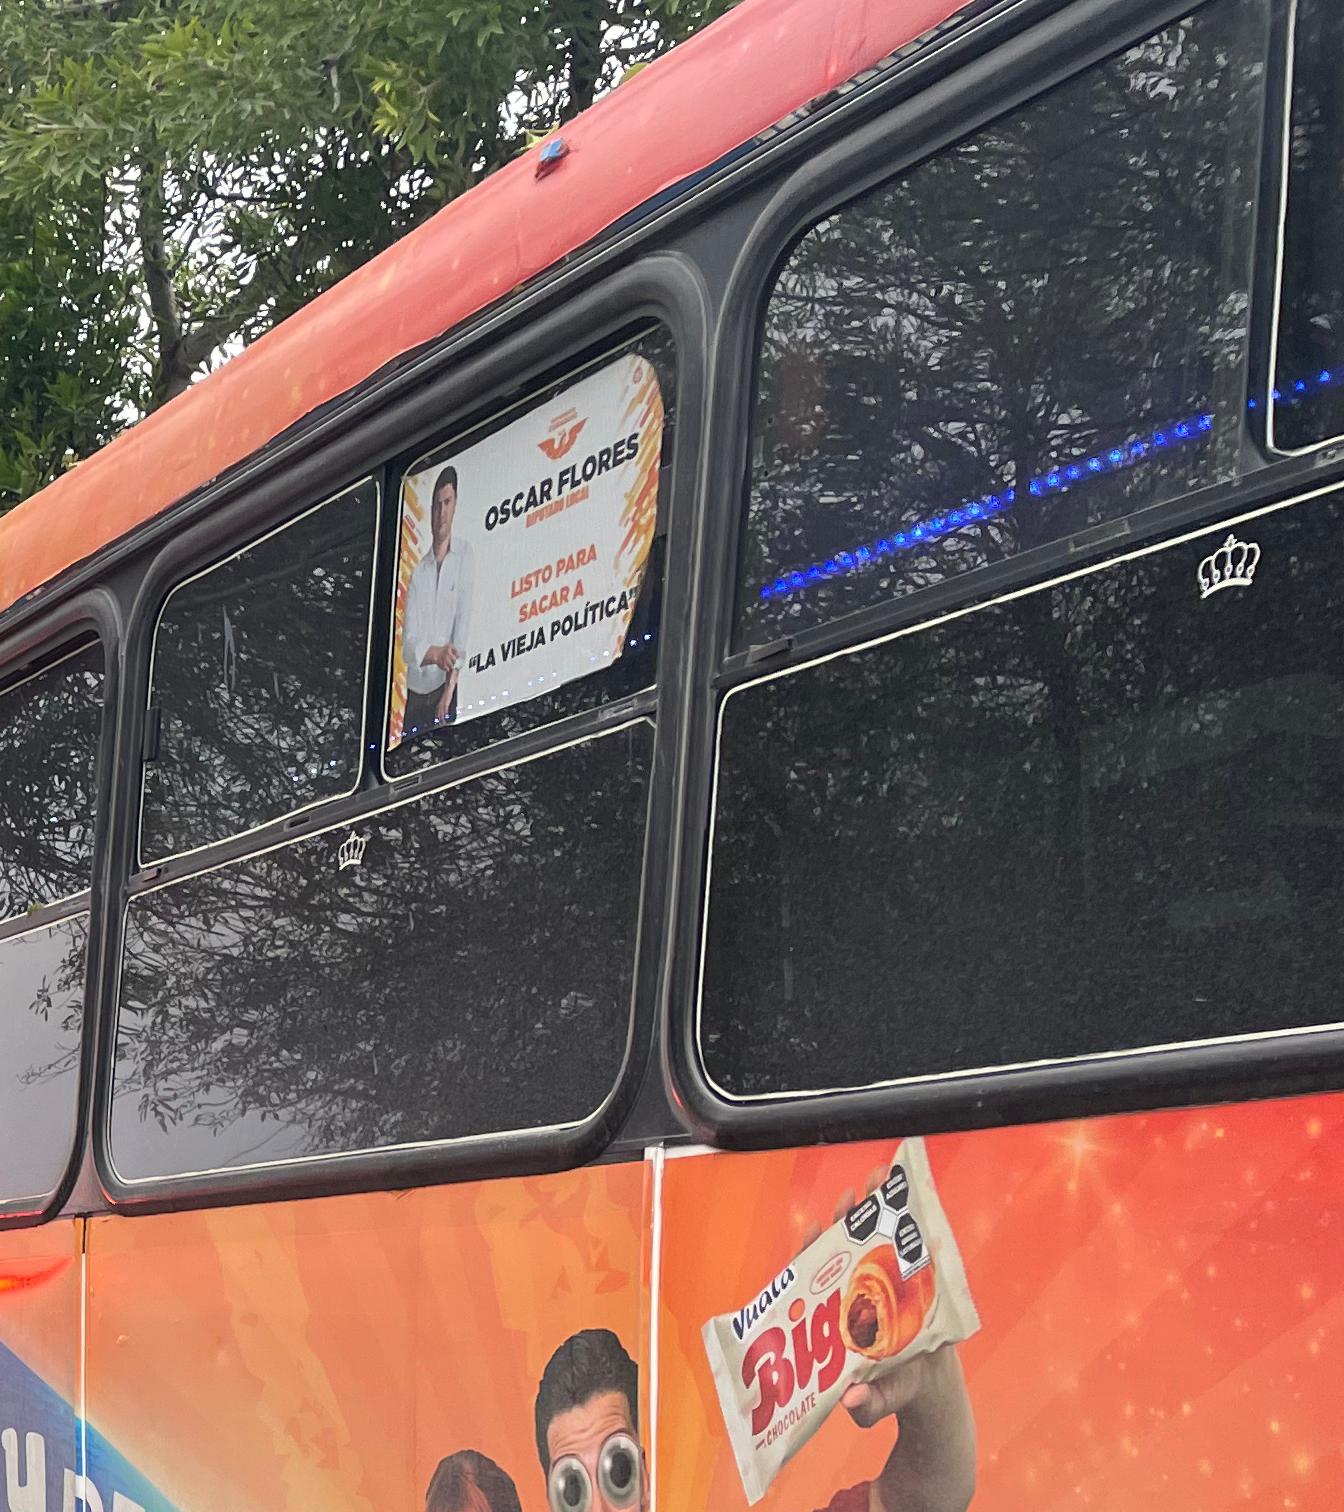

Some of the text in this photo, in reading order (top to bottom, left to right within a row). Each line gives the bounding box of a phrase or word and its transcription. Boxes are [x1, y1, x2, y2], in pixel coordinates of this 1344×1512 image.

[485, 432, 639, 531] OSCAR FLORES
[511, 544, 597, 599] LISTO PARA
[518, 582, 585, 623] SACAR A
[500, 626, 547, 663] VIEJA
[742, 1288, 846, 1436] Big
[766, 1393, 816, 1447] CHOCOLATE
